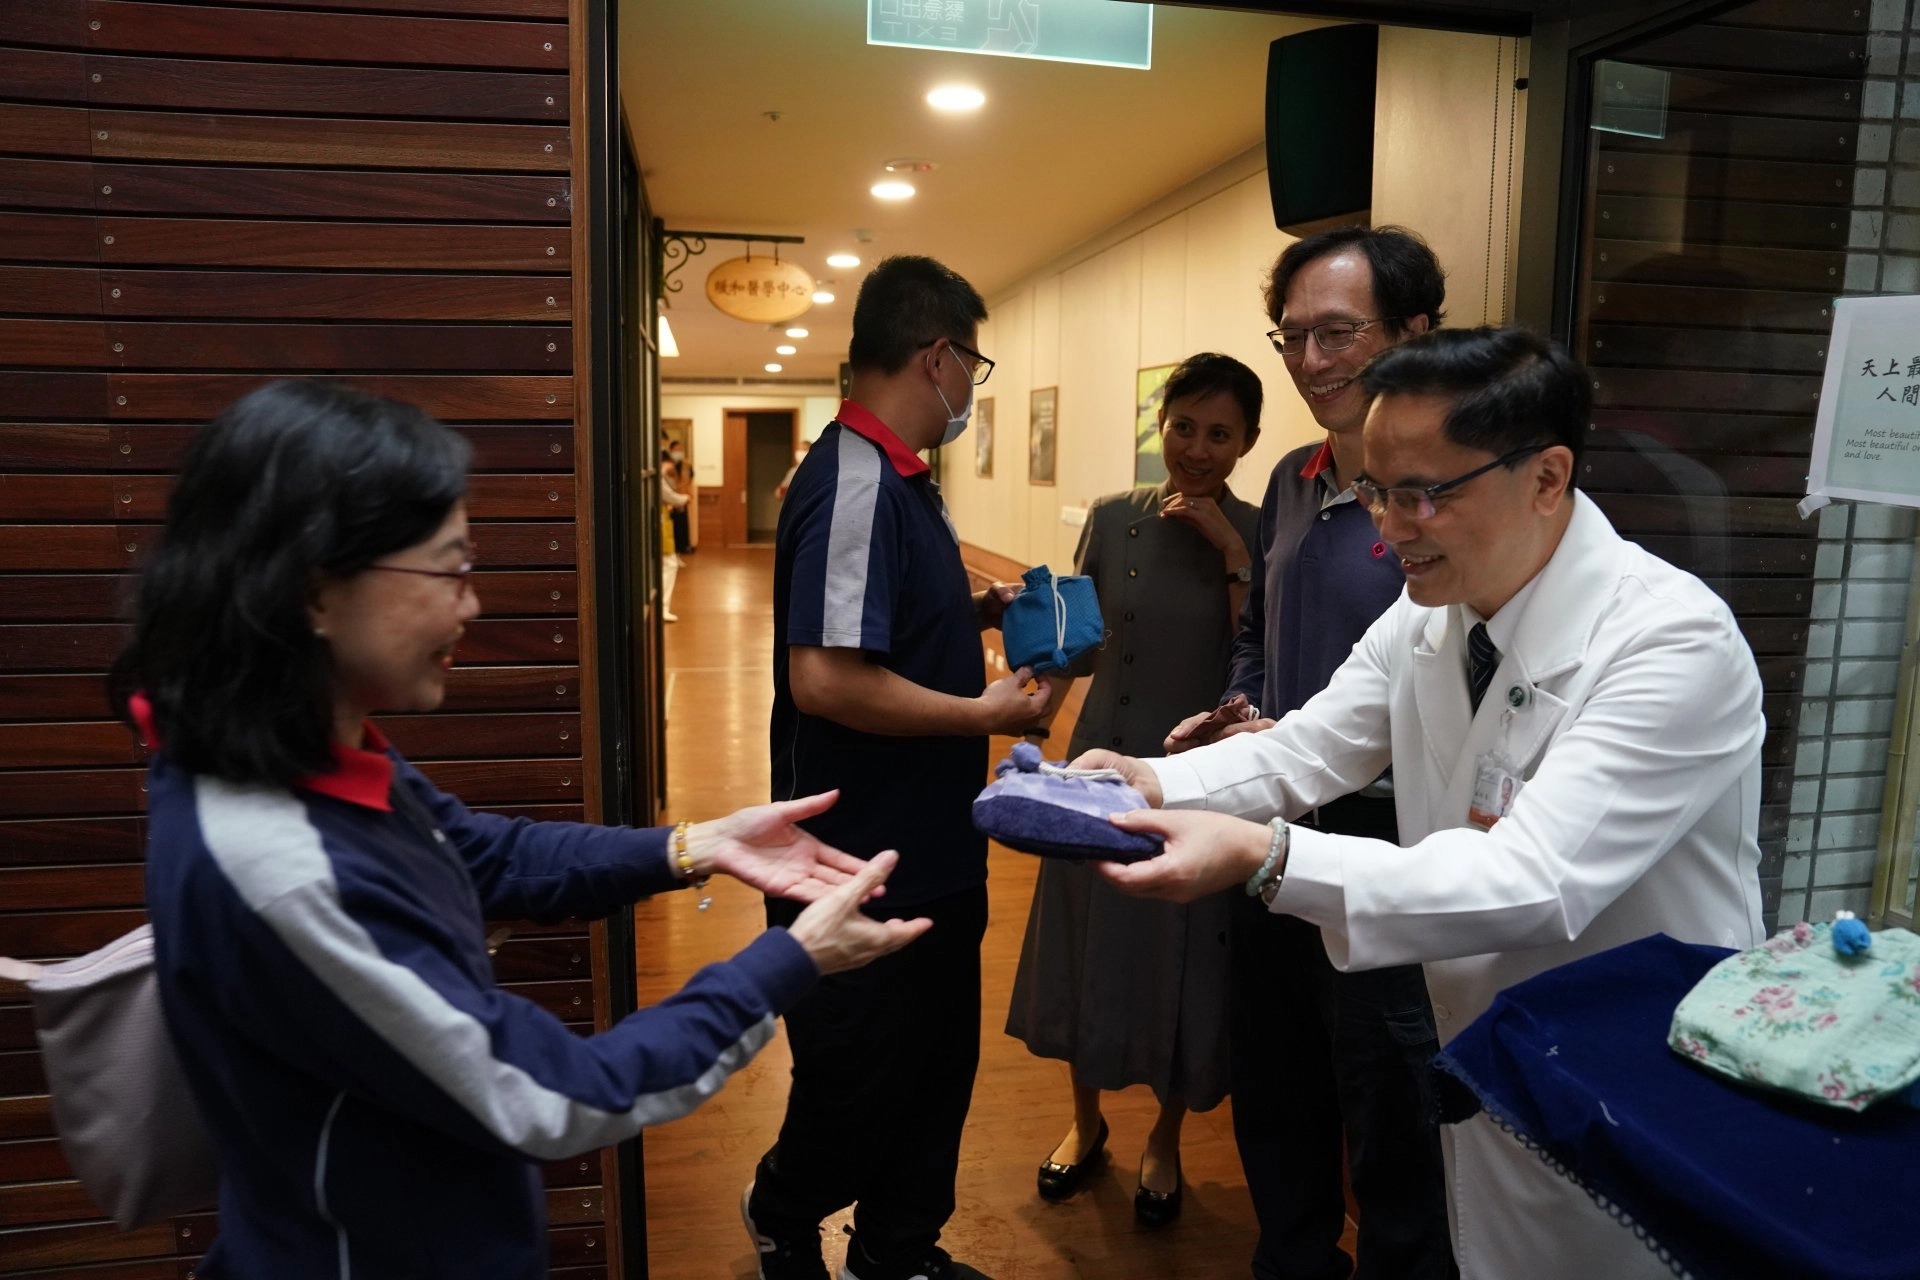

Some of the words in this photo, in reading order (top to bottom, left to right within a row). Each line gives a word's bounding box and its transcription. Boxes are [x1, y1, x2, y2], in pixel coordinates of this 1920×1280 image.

[1861, 356, 1920, 379] 天上最
[1876, 384, 1920, 406] 人間
[1865, 428, 1887, 438] Most
[1846, 439, 1867, 448] Most
[1869, 439, 1910, 451] beautiful
[1844, 450, 1861, 459] and
